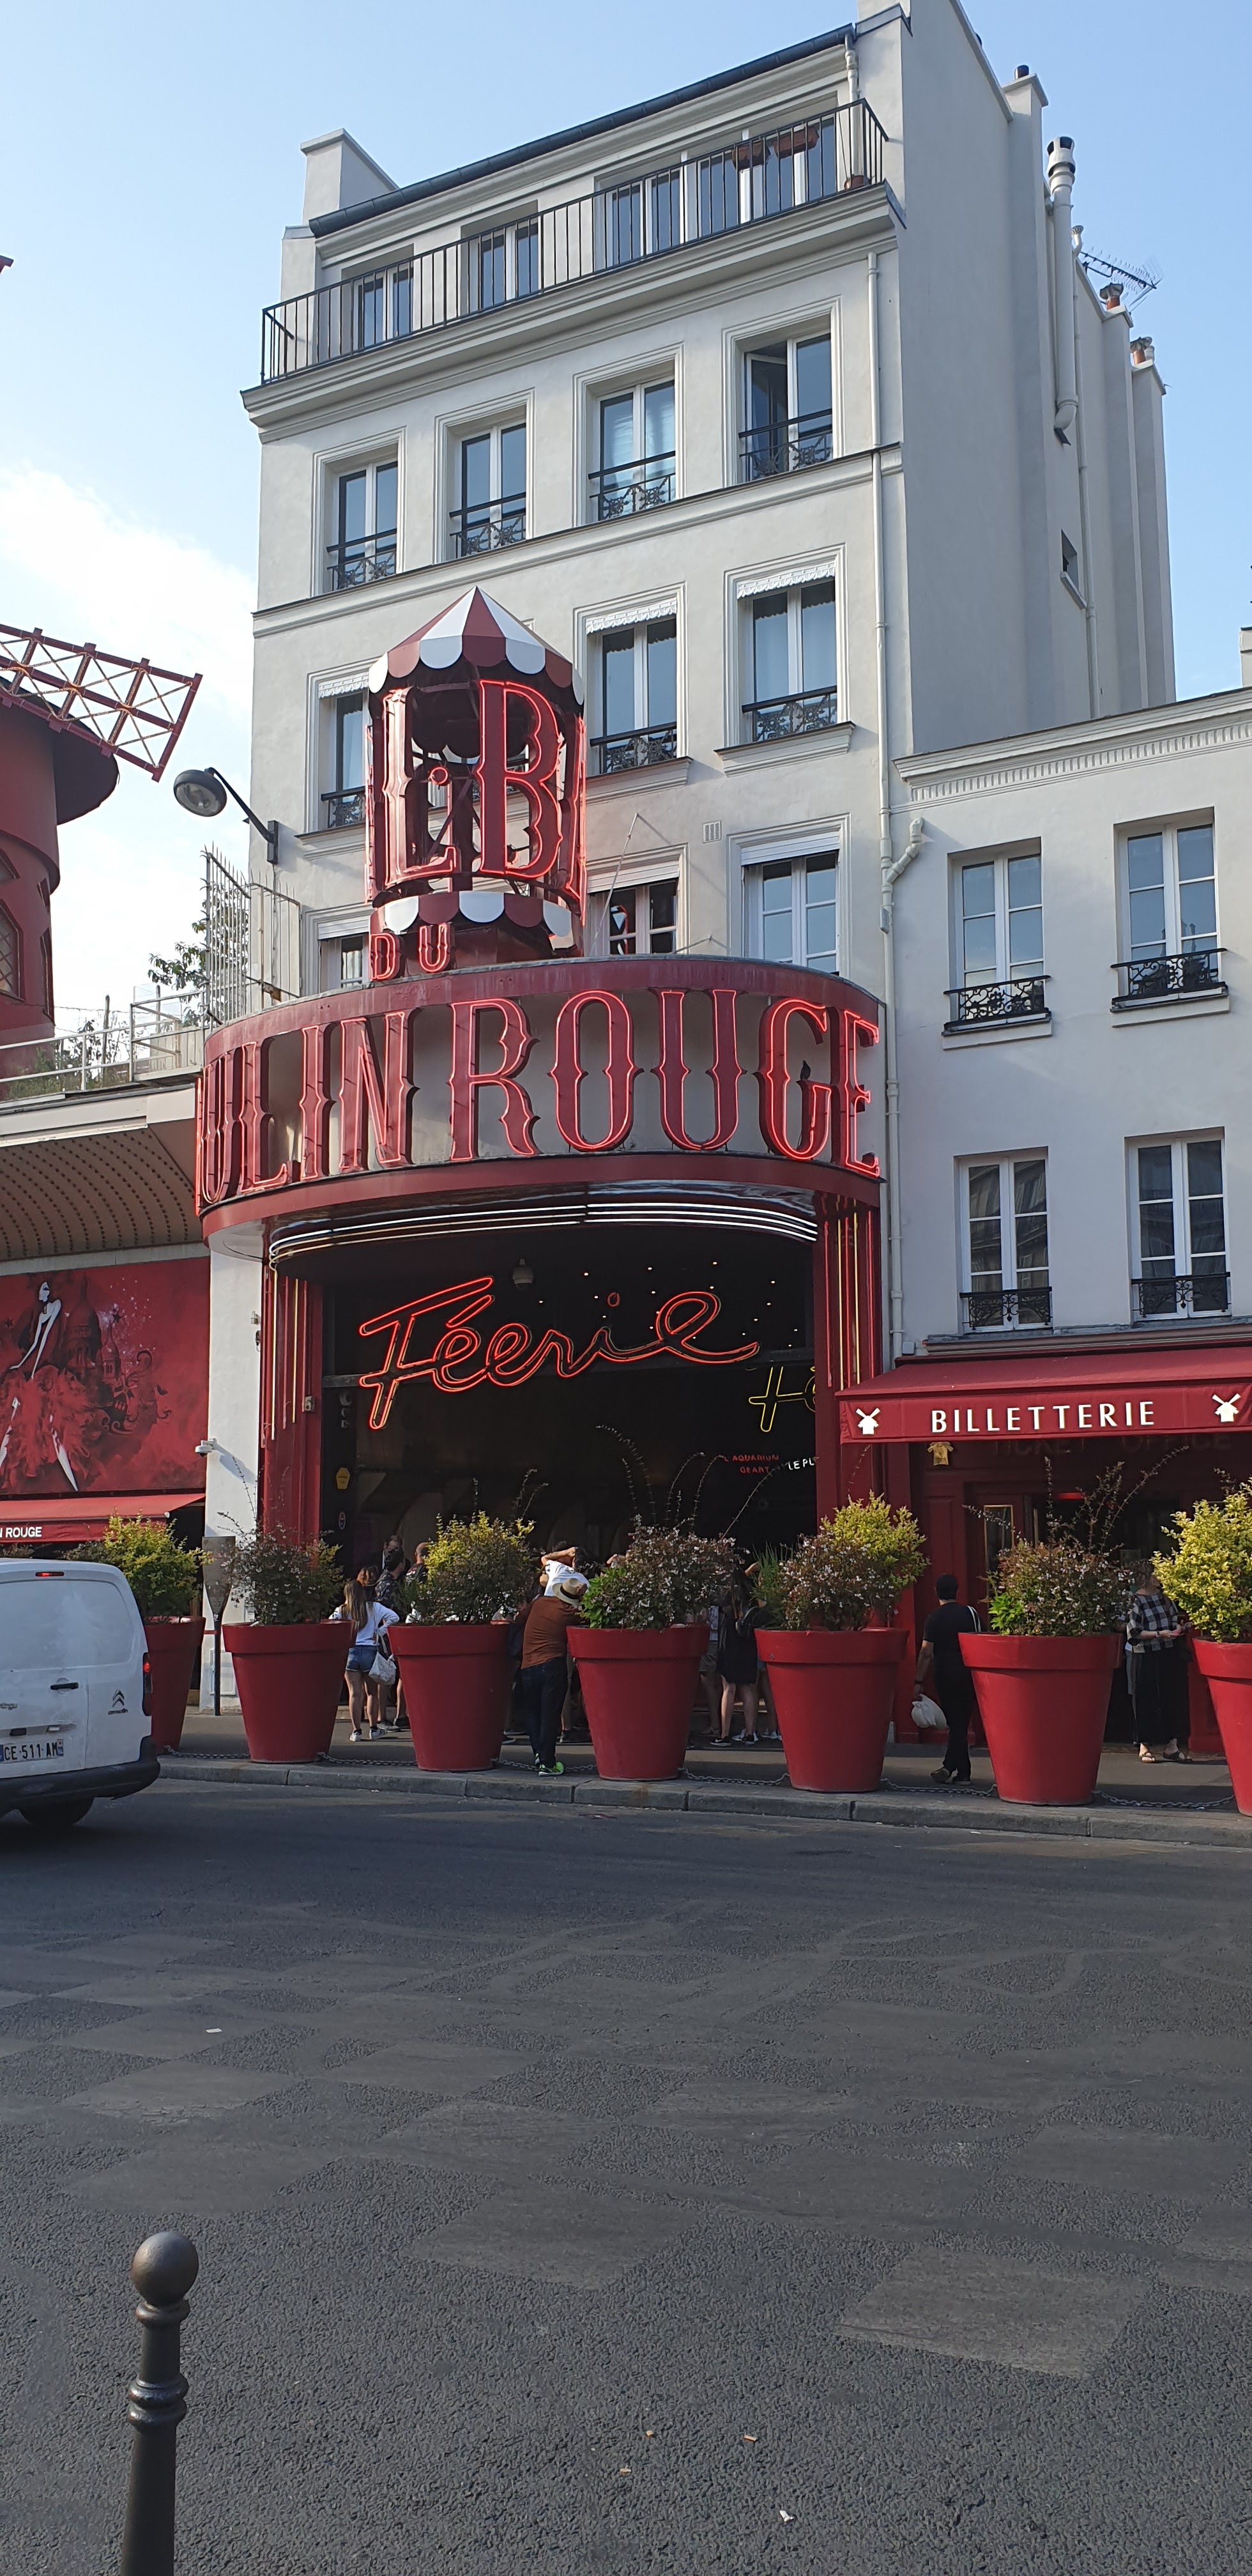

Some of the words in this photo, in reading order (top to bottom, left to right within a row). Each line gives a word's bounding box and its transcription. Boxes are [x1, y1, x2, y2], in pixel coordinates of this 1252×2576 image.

[369, 923, 452, 981] DU
[195, 1009, 416, 1215] ULIN
[448, 989, 880, 1178] ROUGE
[358, 1276, 761, 1430] Féerie
[931, 1400, 1155, 1434] BILLETTERIE
[788, 1460, 800, 1471] LE
[5, 1526, 43, 1538] ROUGE
